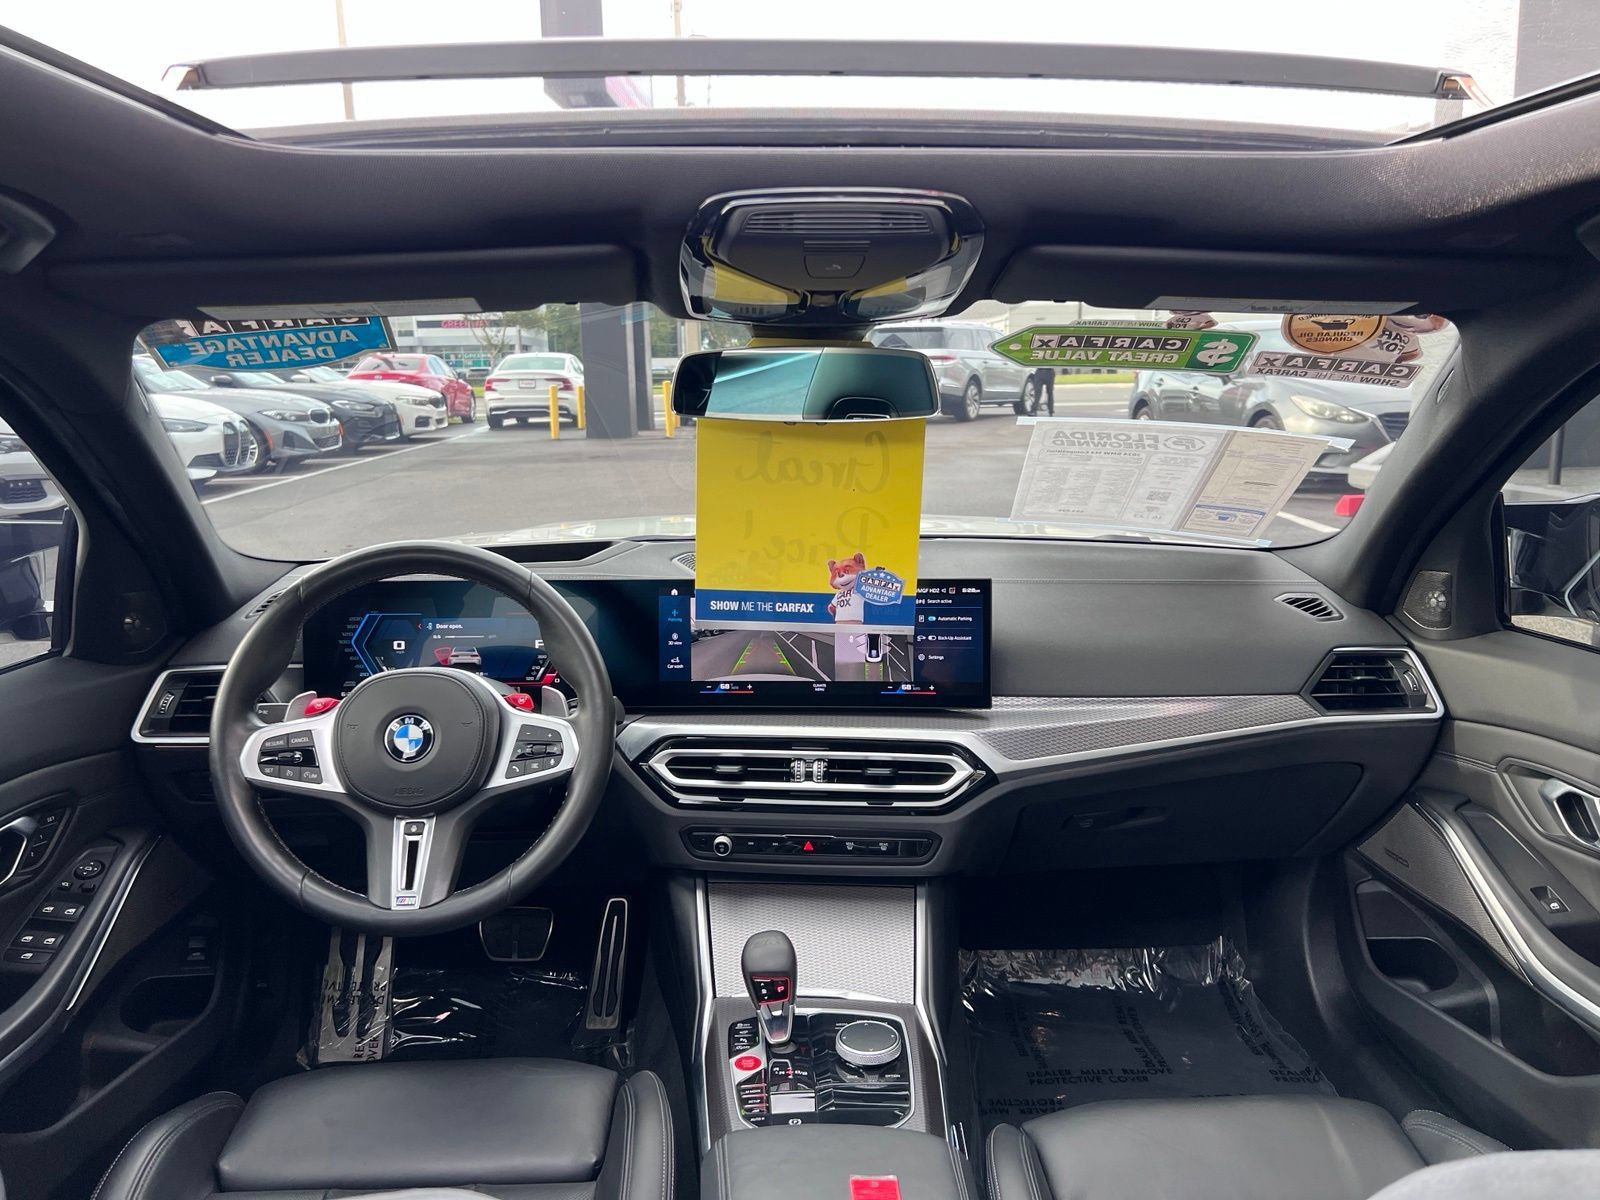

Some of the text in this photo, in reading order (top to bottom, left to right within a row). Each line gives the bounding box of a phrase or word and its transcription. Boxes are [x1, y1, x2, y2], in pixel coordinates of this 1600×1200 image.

[860, 576, 901, 592] CARFAX
[860, 585, 896, 598] ADVANTAGE
[865, 592, 889, 602] DEALER
[709, 600, 814, 613] SHOW ME THE CARFAX
[836, 598, 851, 608] FOX
[777, 985, 785, 993] P
[1027, 1068, 1173, 1078] DEALER MUST REMOVE
[1029, 1075, 1149, 1087] PROTECTIVE COVER
